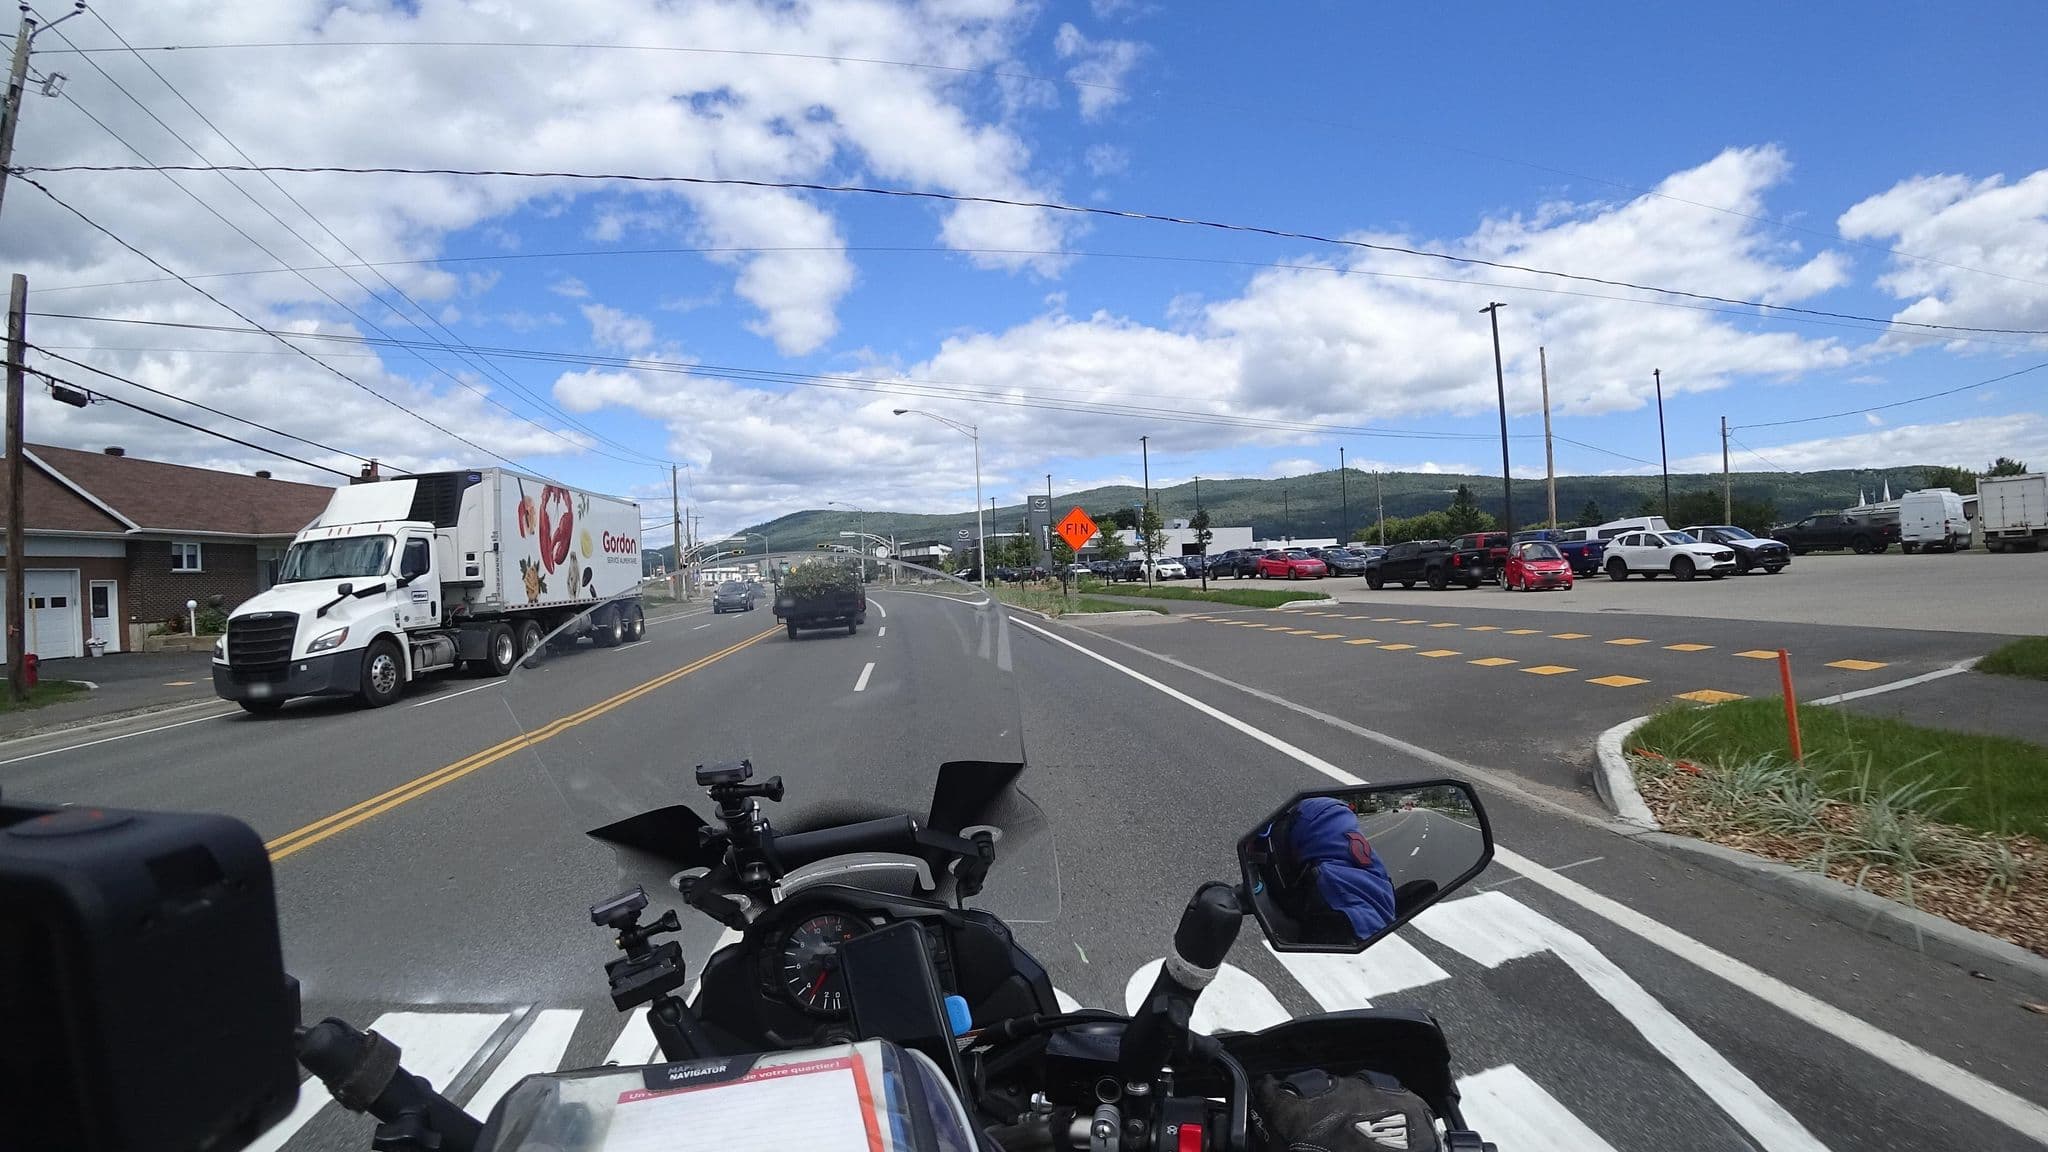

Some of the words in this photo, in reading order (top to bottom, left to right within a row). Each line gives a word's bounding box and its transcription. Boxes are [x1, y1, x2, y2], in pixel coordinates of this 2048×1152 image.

[1066, 523, 1089, 535] FIN
[602, 530, 637, 555] Gordon
[669, 1065, 727, 1080] NAVIGATOR
[759, 1069, 788, 1078] votre
[790, 1061, 840, 1074] quartier!
